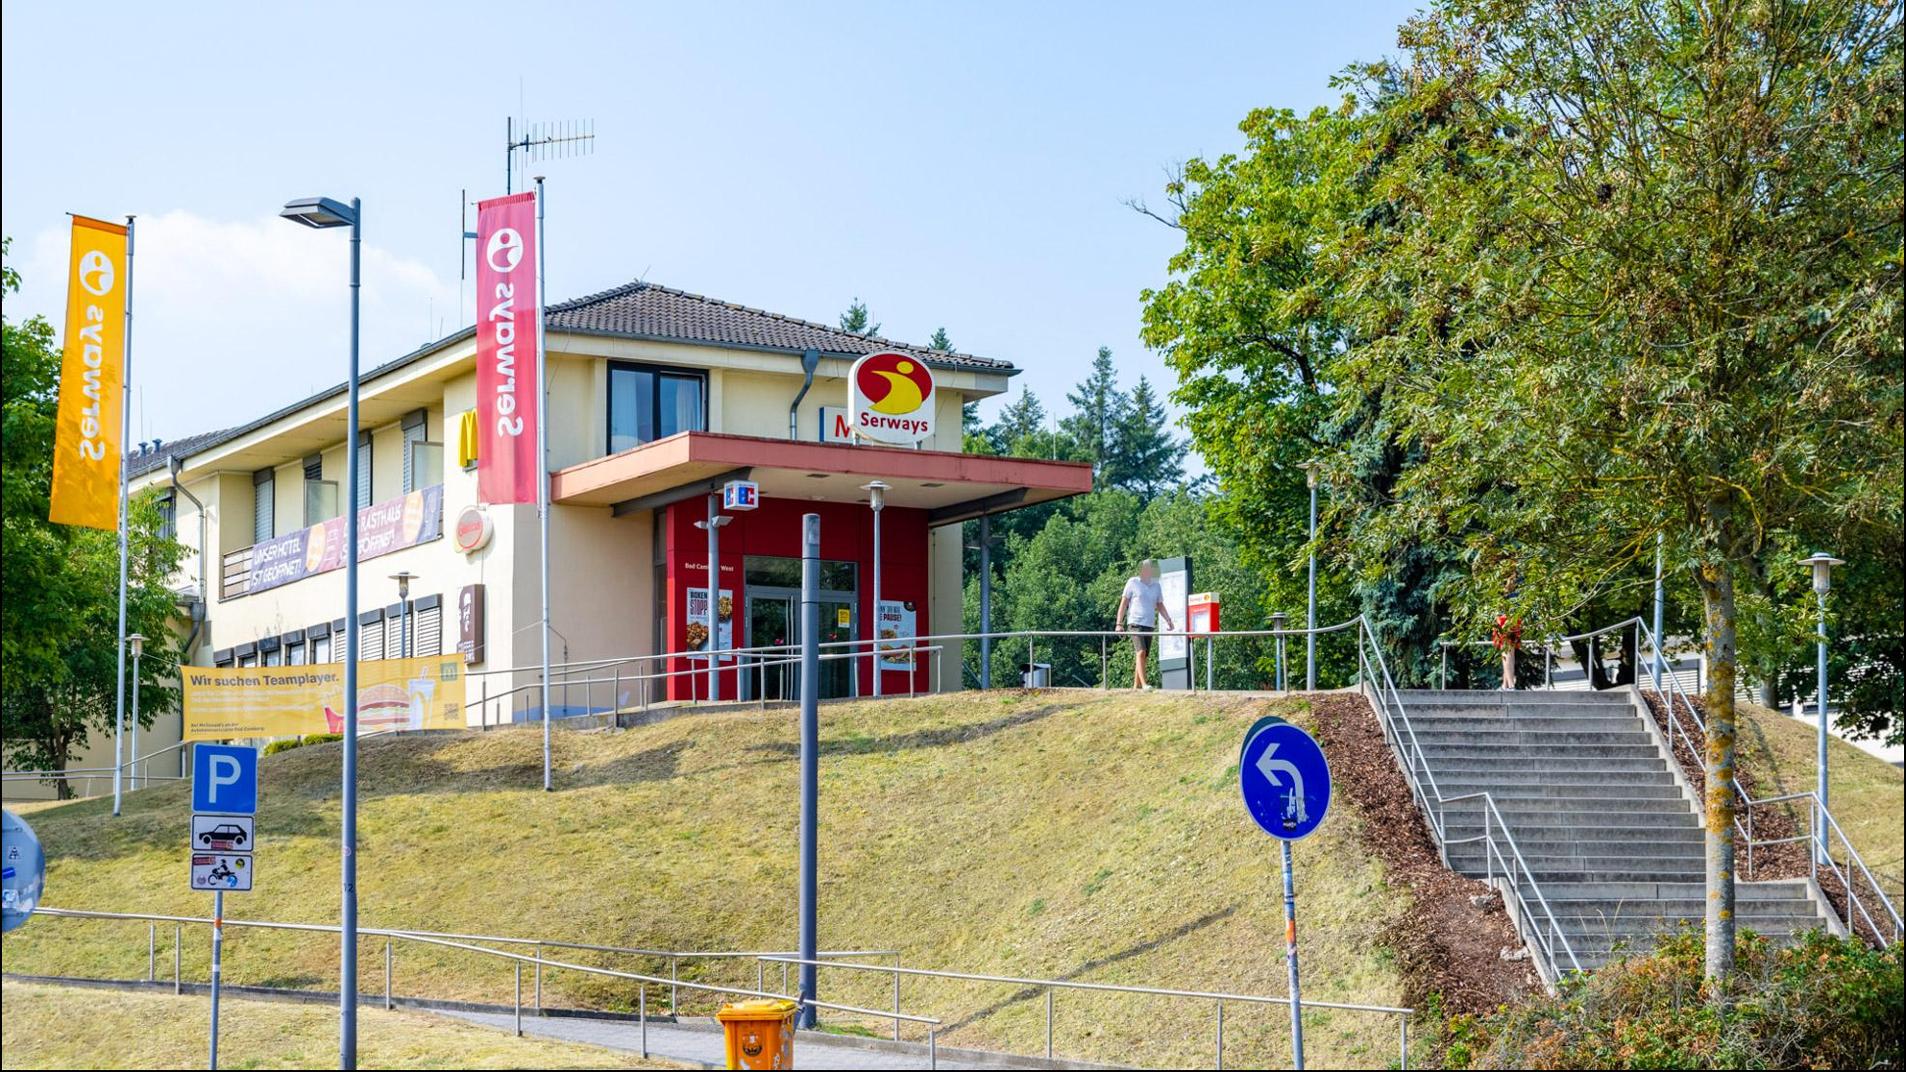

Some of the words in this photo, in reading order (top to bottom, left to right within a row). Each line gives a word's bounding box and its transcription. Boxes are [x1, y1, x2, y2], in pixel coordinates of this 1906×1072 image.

[860, 412, 928, 435] Serways
[190, 675, 212, 687] Wir
[215, 675, 261, 687] suchen
[263, 673, 339, 687] Teamplayer.
[208, 754, 241, 804] P
